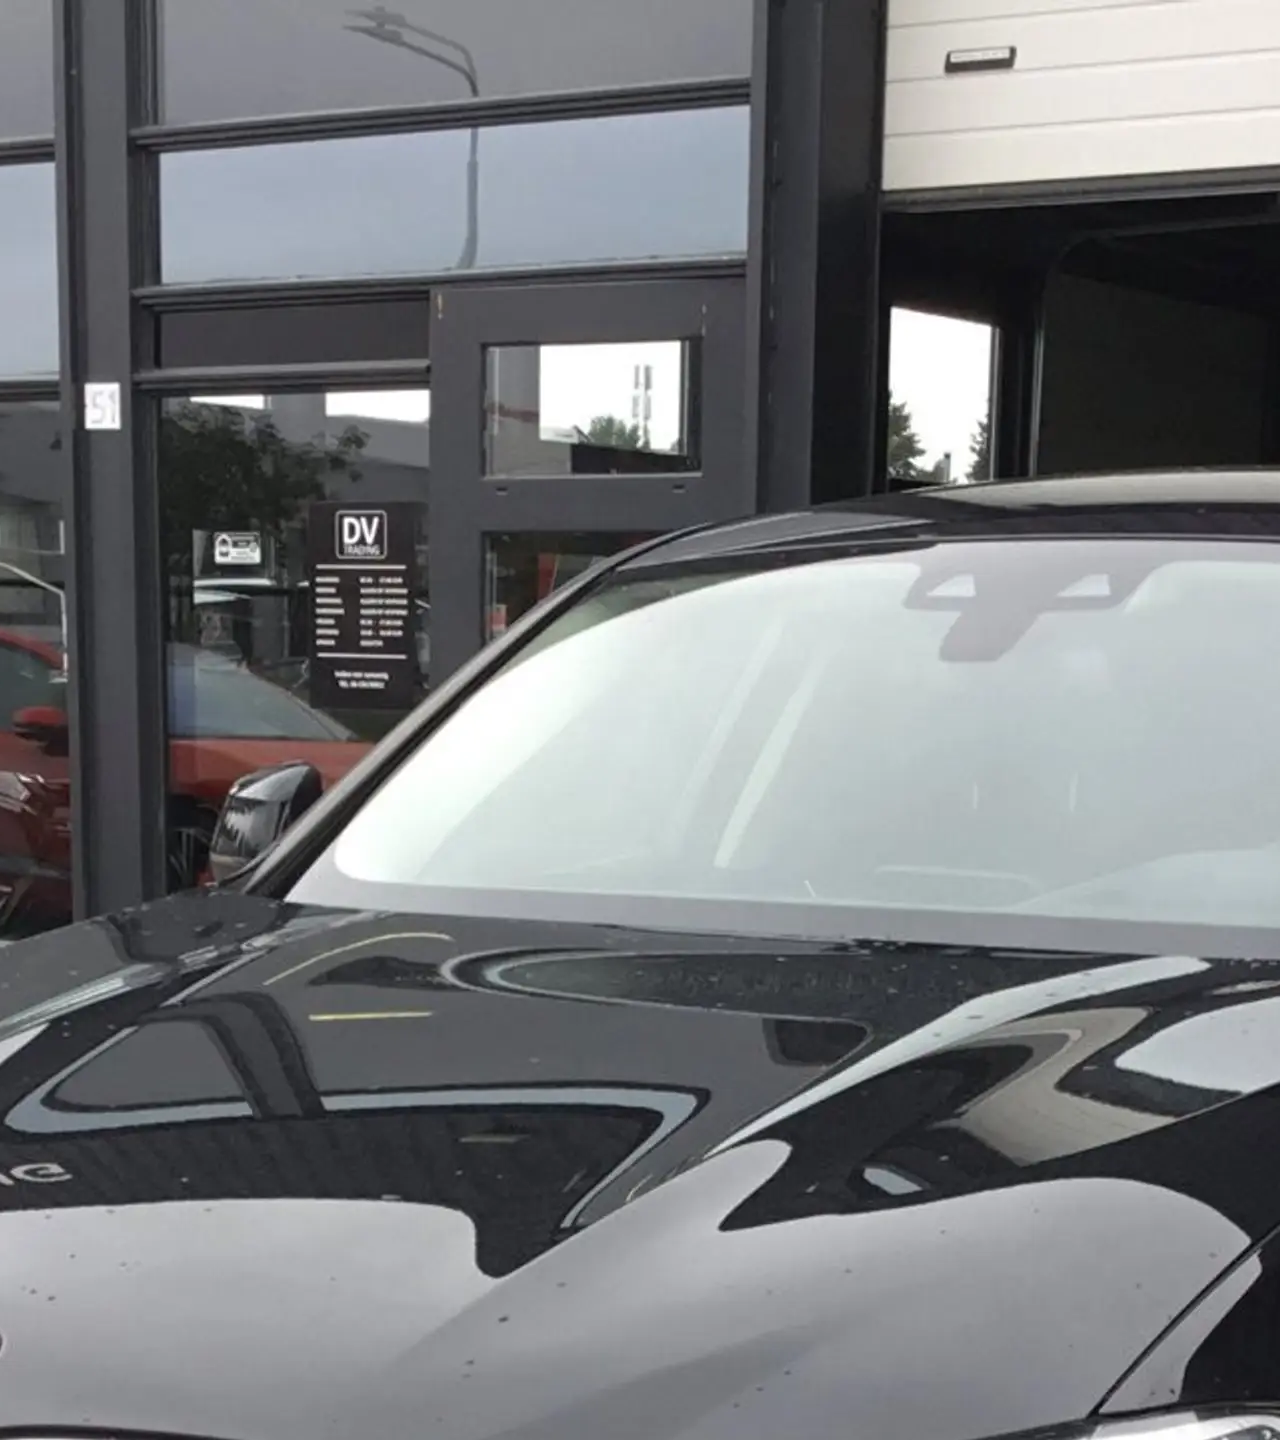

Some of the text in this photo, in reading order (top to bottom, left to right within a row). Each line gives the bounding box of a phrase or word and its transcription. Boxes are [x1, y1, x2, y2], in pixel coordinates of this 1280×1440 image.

[90, 390, 116, 424] 51
[342, 516, 380, 544] DV
[343, 544, 380, 556] TRADING
